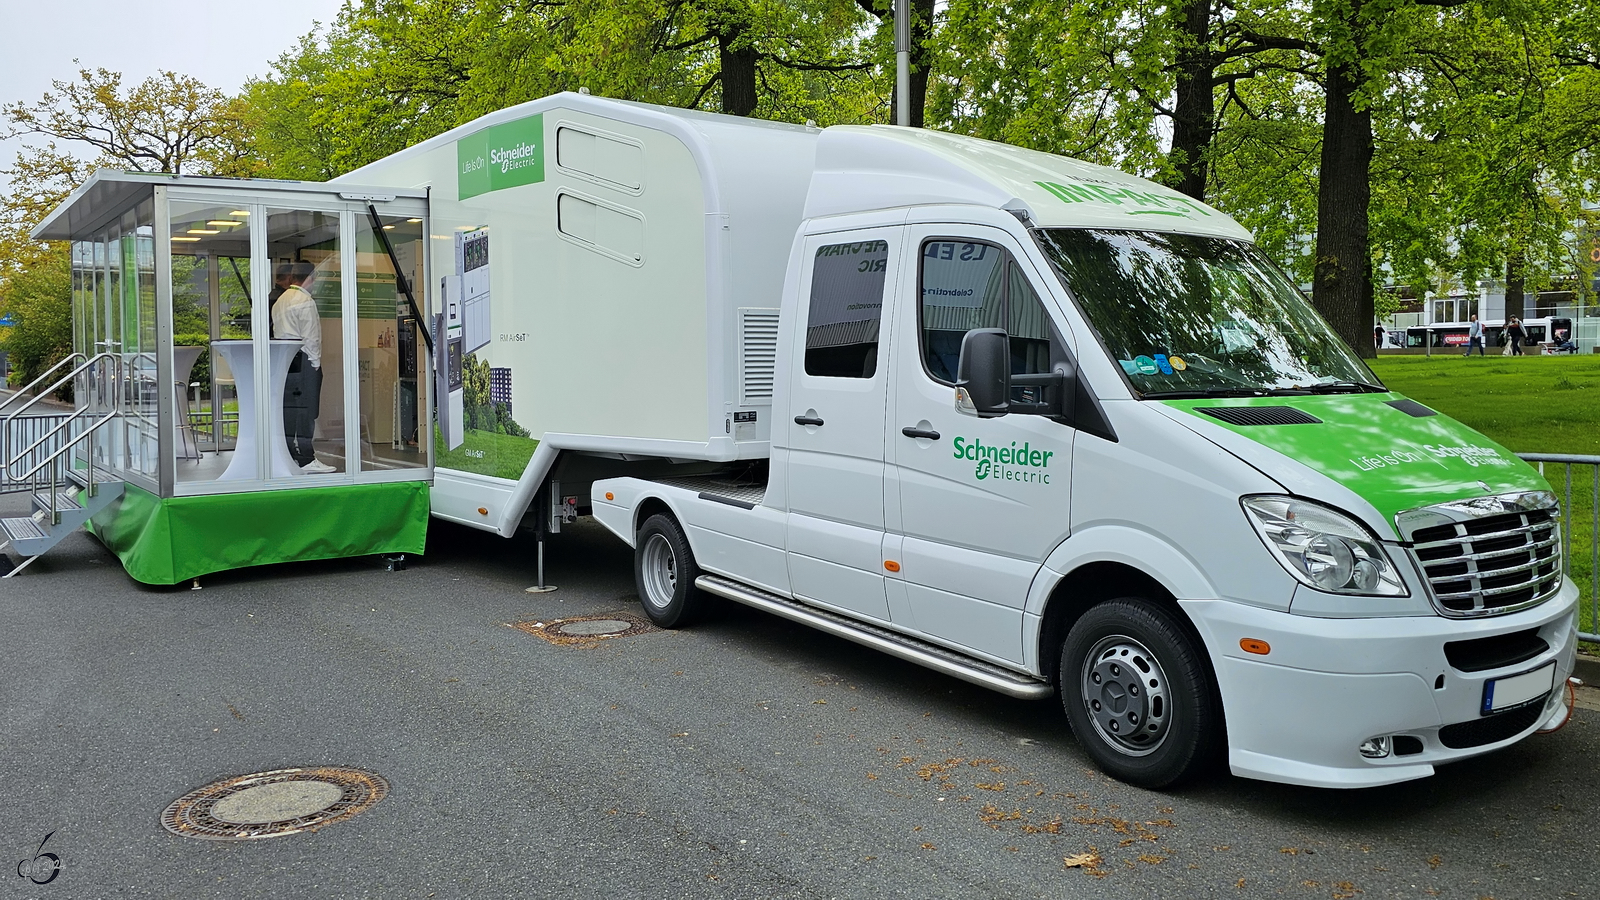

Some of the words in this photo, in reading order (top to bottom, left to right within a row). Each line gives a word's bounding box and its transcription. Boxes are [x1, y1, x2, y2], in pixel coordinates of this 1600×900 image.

[490, 142, 536, 165] Schneider
[509, 157, 535, 170] Electric
[462, 160, 472, 174] Life
[953, 436, 1054, 468] Schneider
[1349, 456, 1386, 472] Life
[1375, 453, 1400, 466] Is
[1391, 449, 1423, 463] On
[1422, 443, 1502, 458] Schneider
[993, 464, 1050, 485] Electric
